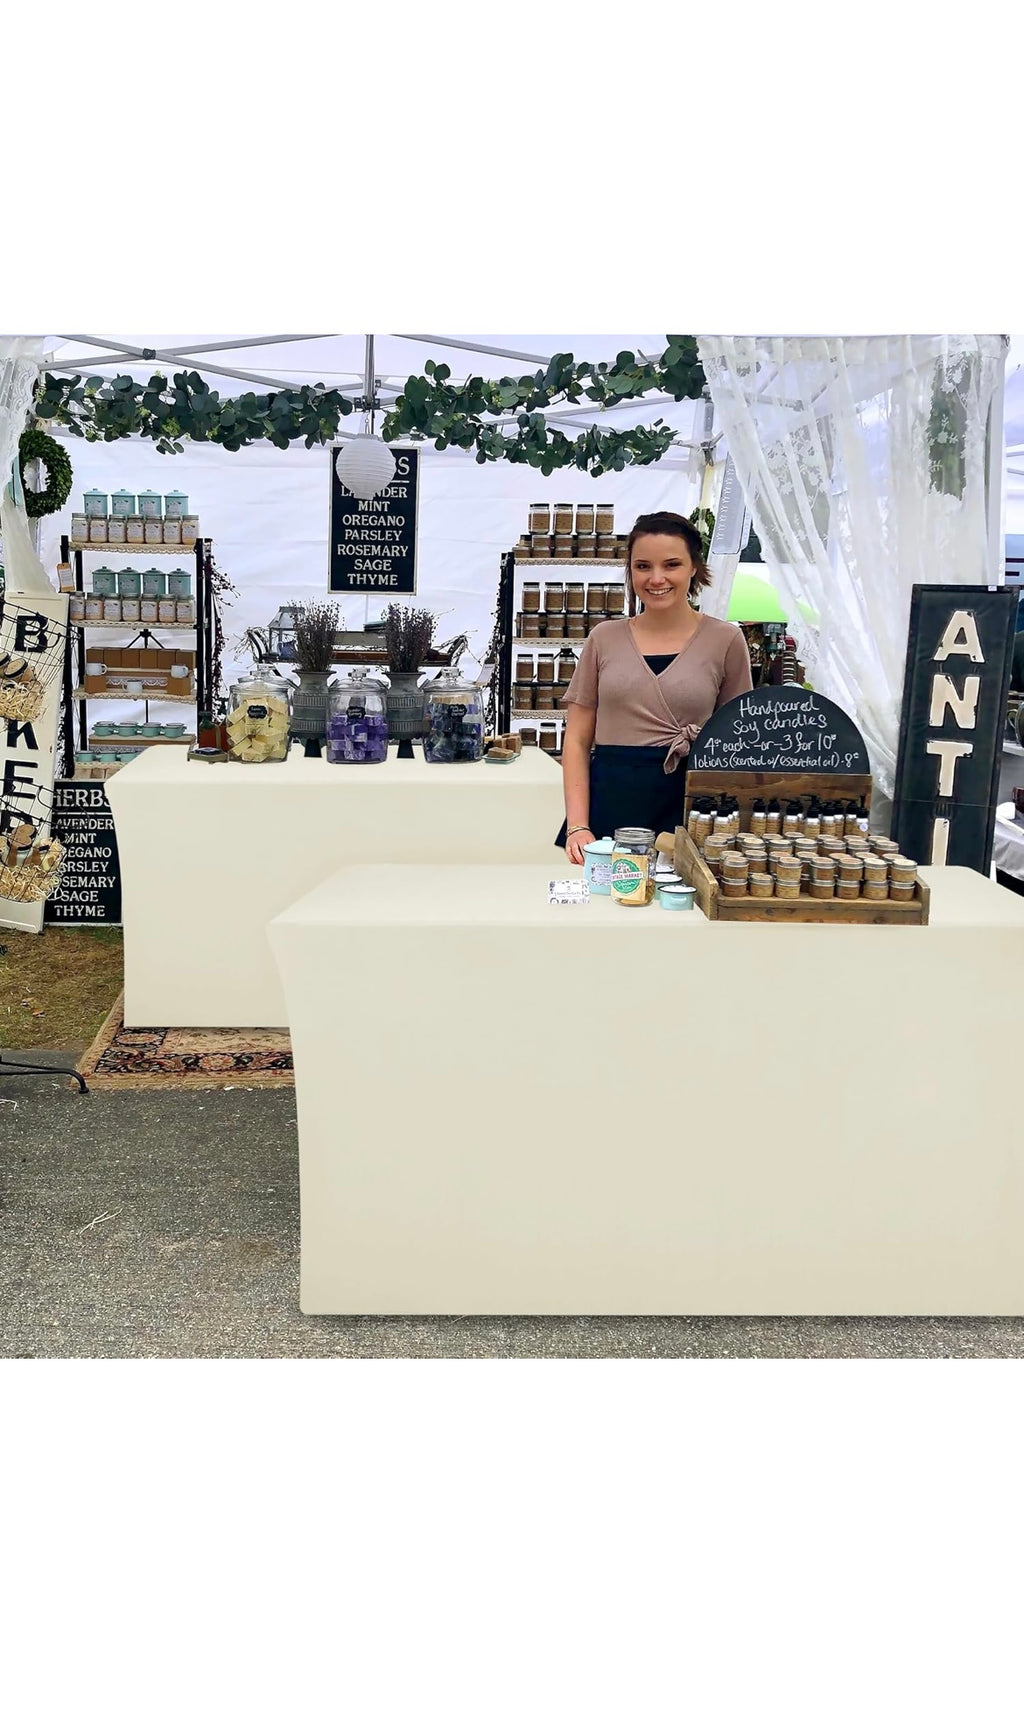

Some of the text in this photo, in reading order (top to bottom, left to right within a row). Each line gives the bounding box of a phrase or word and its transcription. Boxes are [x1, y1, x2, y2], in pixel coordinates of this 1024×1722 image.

[358, 501, 390, 512] MINT
[342, 514, 405, 527] OREGANO
[345, 529, 402, 541] PARSLEY
[337, 544, 408, 557] ROSEMARY
[354, 559, 392, 571] SAGE
[347, 573, 398, 586] THYME
[739, 695, 820, 719] Handpoured
[733, 719, 760, 744] Soy
[722, 737, 750, 752] each
[780, 734, 793, 751] 3
[794, 732, 815, 753] for
[694, 754, 728, 769] lotions
[61, 890, 99, 902] SAGE
[54, 905, 105, 917] THYME
